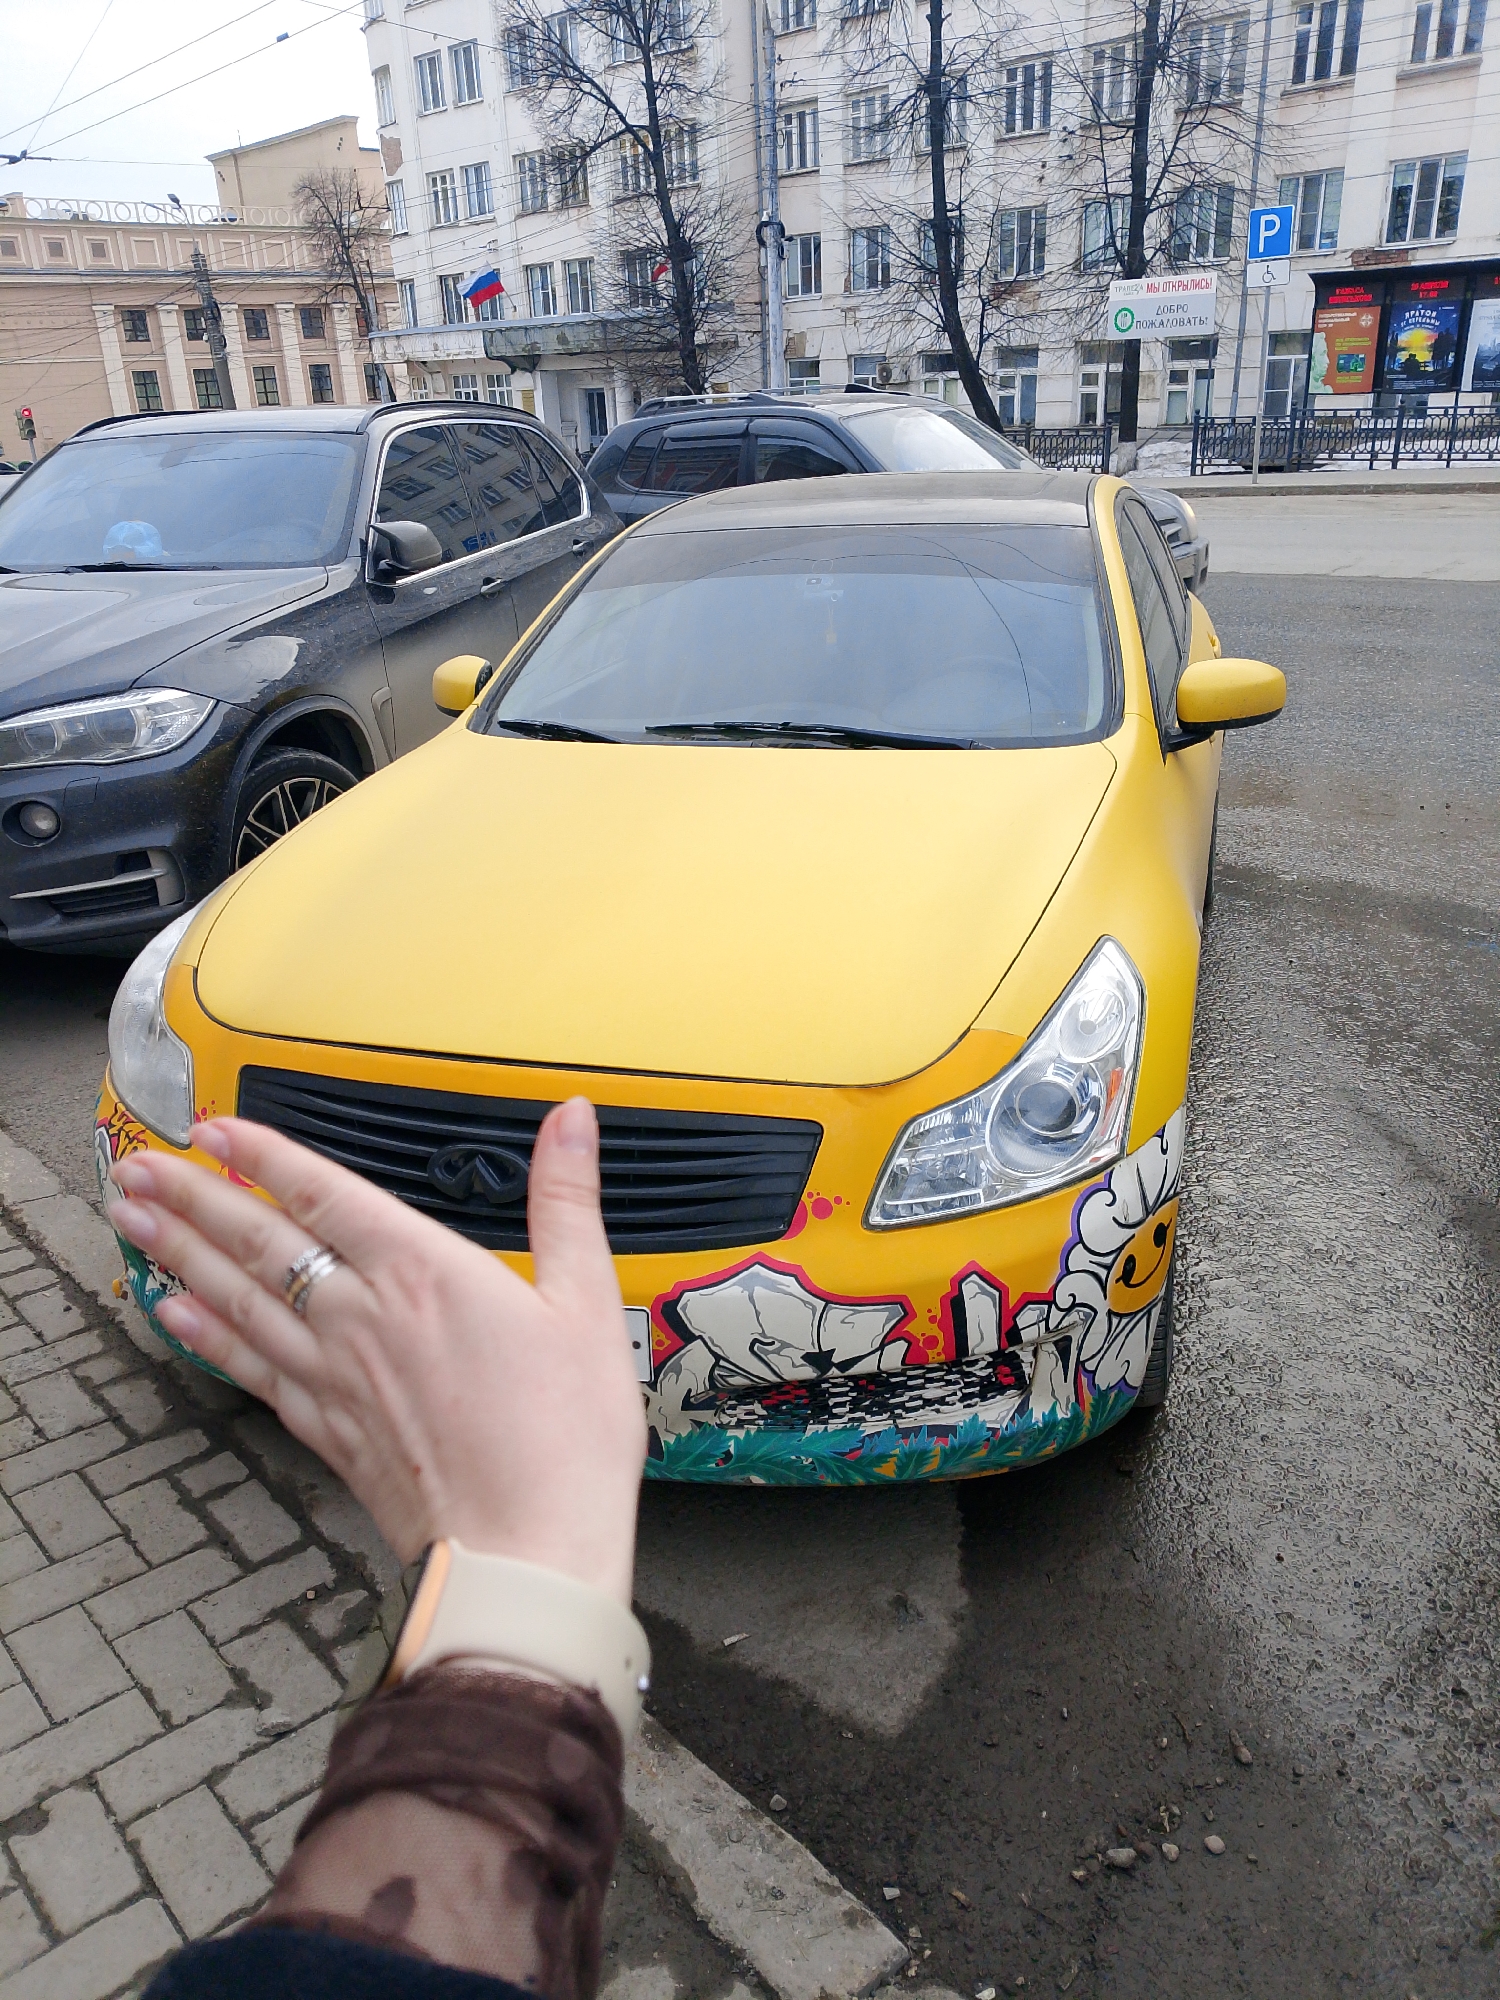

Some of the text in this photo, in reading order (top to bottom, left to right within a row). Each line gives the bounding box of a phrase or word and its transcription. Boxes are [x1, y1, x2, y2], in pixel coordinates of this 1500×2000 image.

[1259, 214, 1281, 253] P
[1146, 277, 1213, 294] МЫ ОТКРЫЛИСЬ!
[1156, 304, 1188, 316] ДОБРО
[1135, 316, 1208, 330] ПОЖАЛОВАТЬ!
